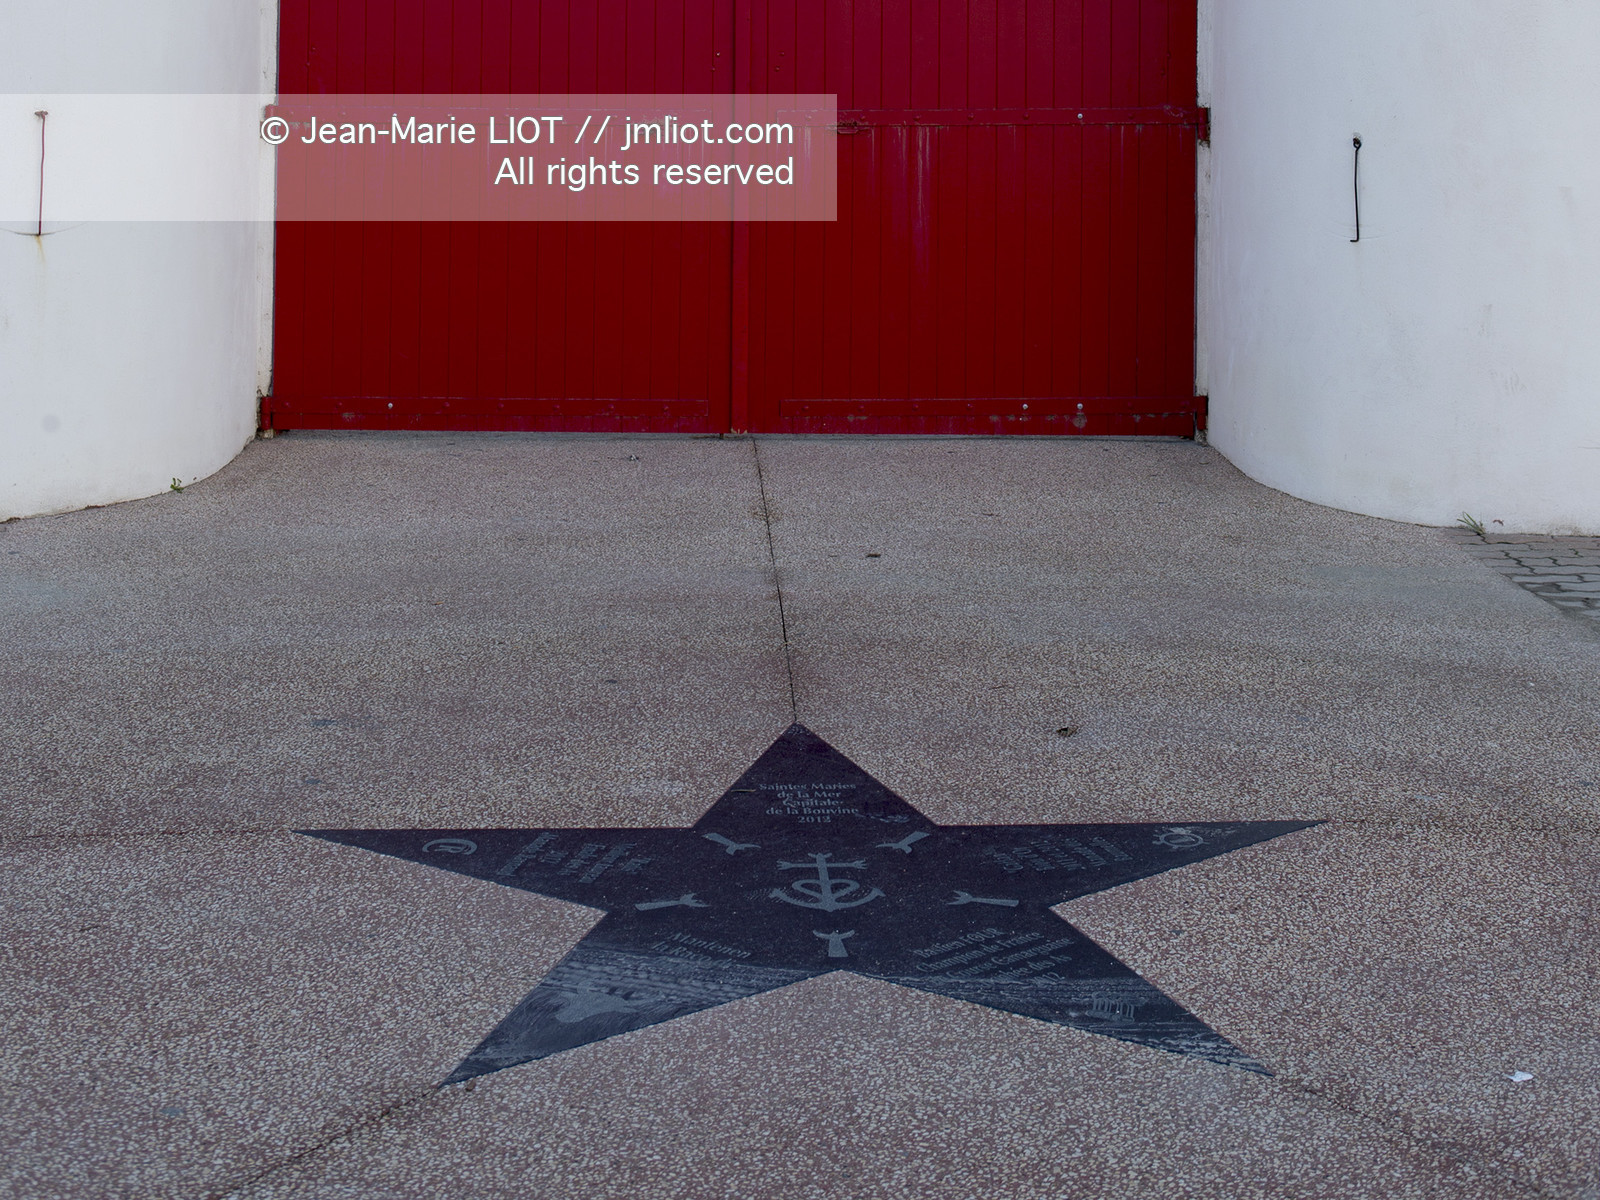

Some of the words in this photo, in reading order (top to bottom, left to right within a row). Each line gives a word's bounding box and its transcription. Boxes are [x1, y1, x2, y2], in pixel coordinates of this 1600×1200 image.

[811, 782, 857, 791] Maries
[777, 791, 793, 799] de
[766, 807, 783, 815] de
[787, 807, 799, 815] la
[803, 806, 859, 815] Bouvine
[916, 951, 986, 973] Champion
[997, 932, 1045, 947] France
[991, 938, 1075, 965] Camarguaise
